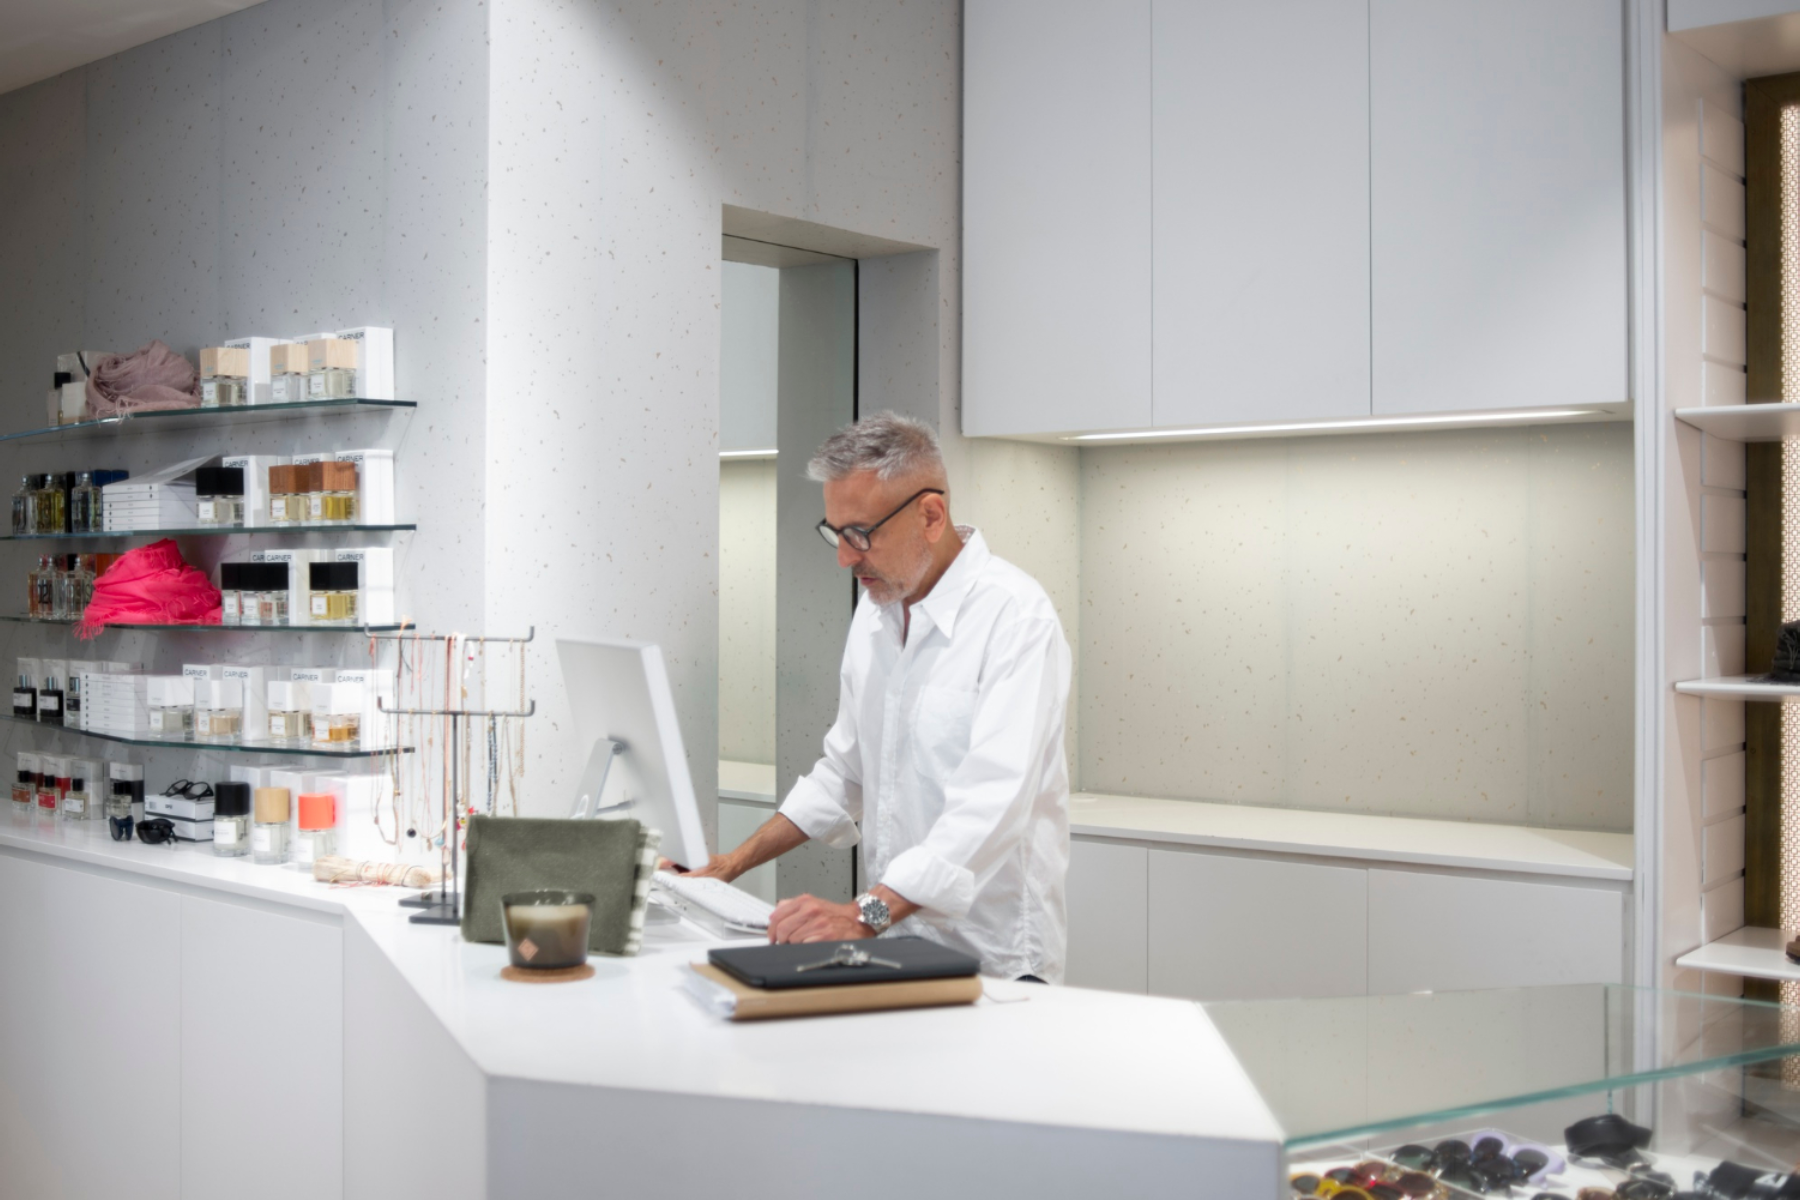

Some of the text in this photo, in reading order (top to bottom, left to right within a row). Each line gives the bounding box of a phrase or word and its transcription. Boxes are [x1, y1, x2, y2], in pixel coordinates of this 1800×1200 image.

[266, 554, 292, 562] CARNER
[337, 553, 364, 561] CARNER
[184, 668, 208, 677] CARNER
[224, 670, 249, 679] CARNER
[293, 673, 318, 682] CARNER
[337, 675, 365, 683] CARNER
